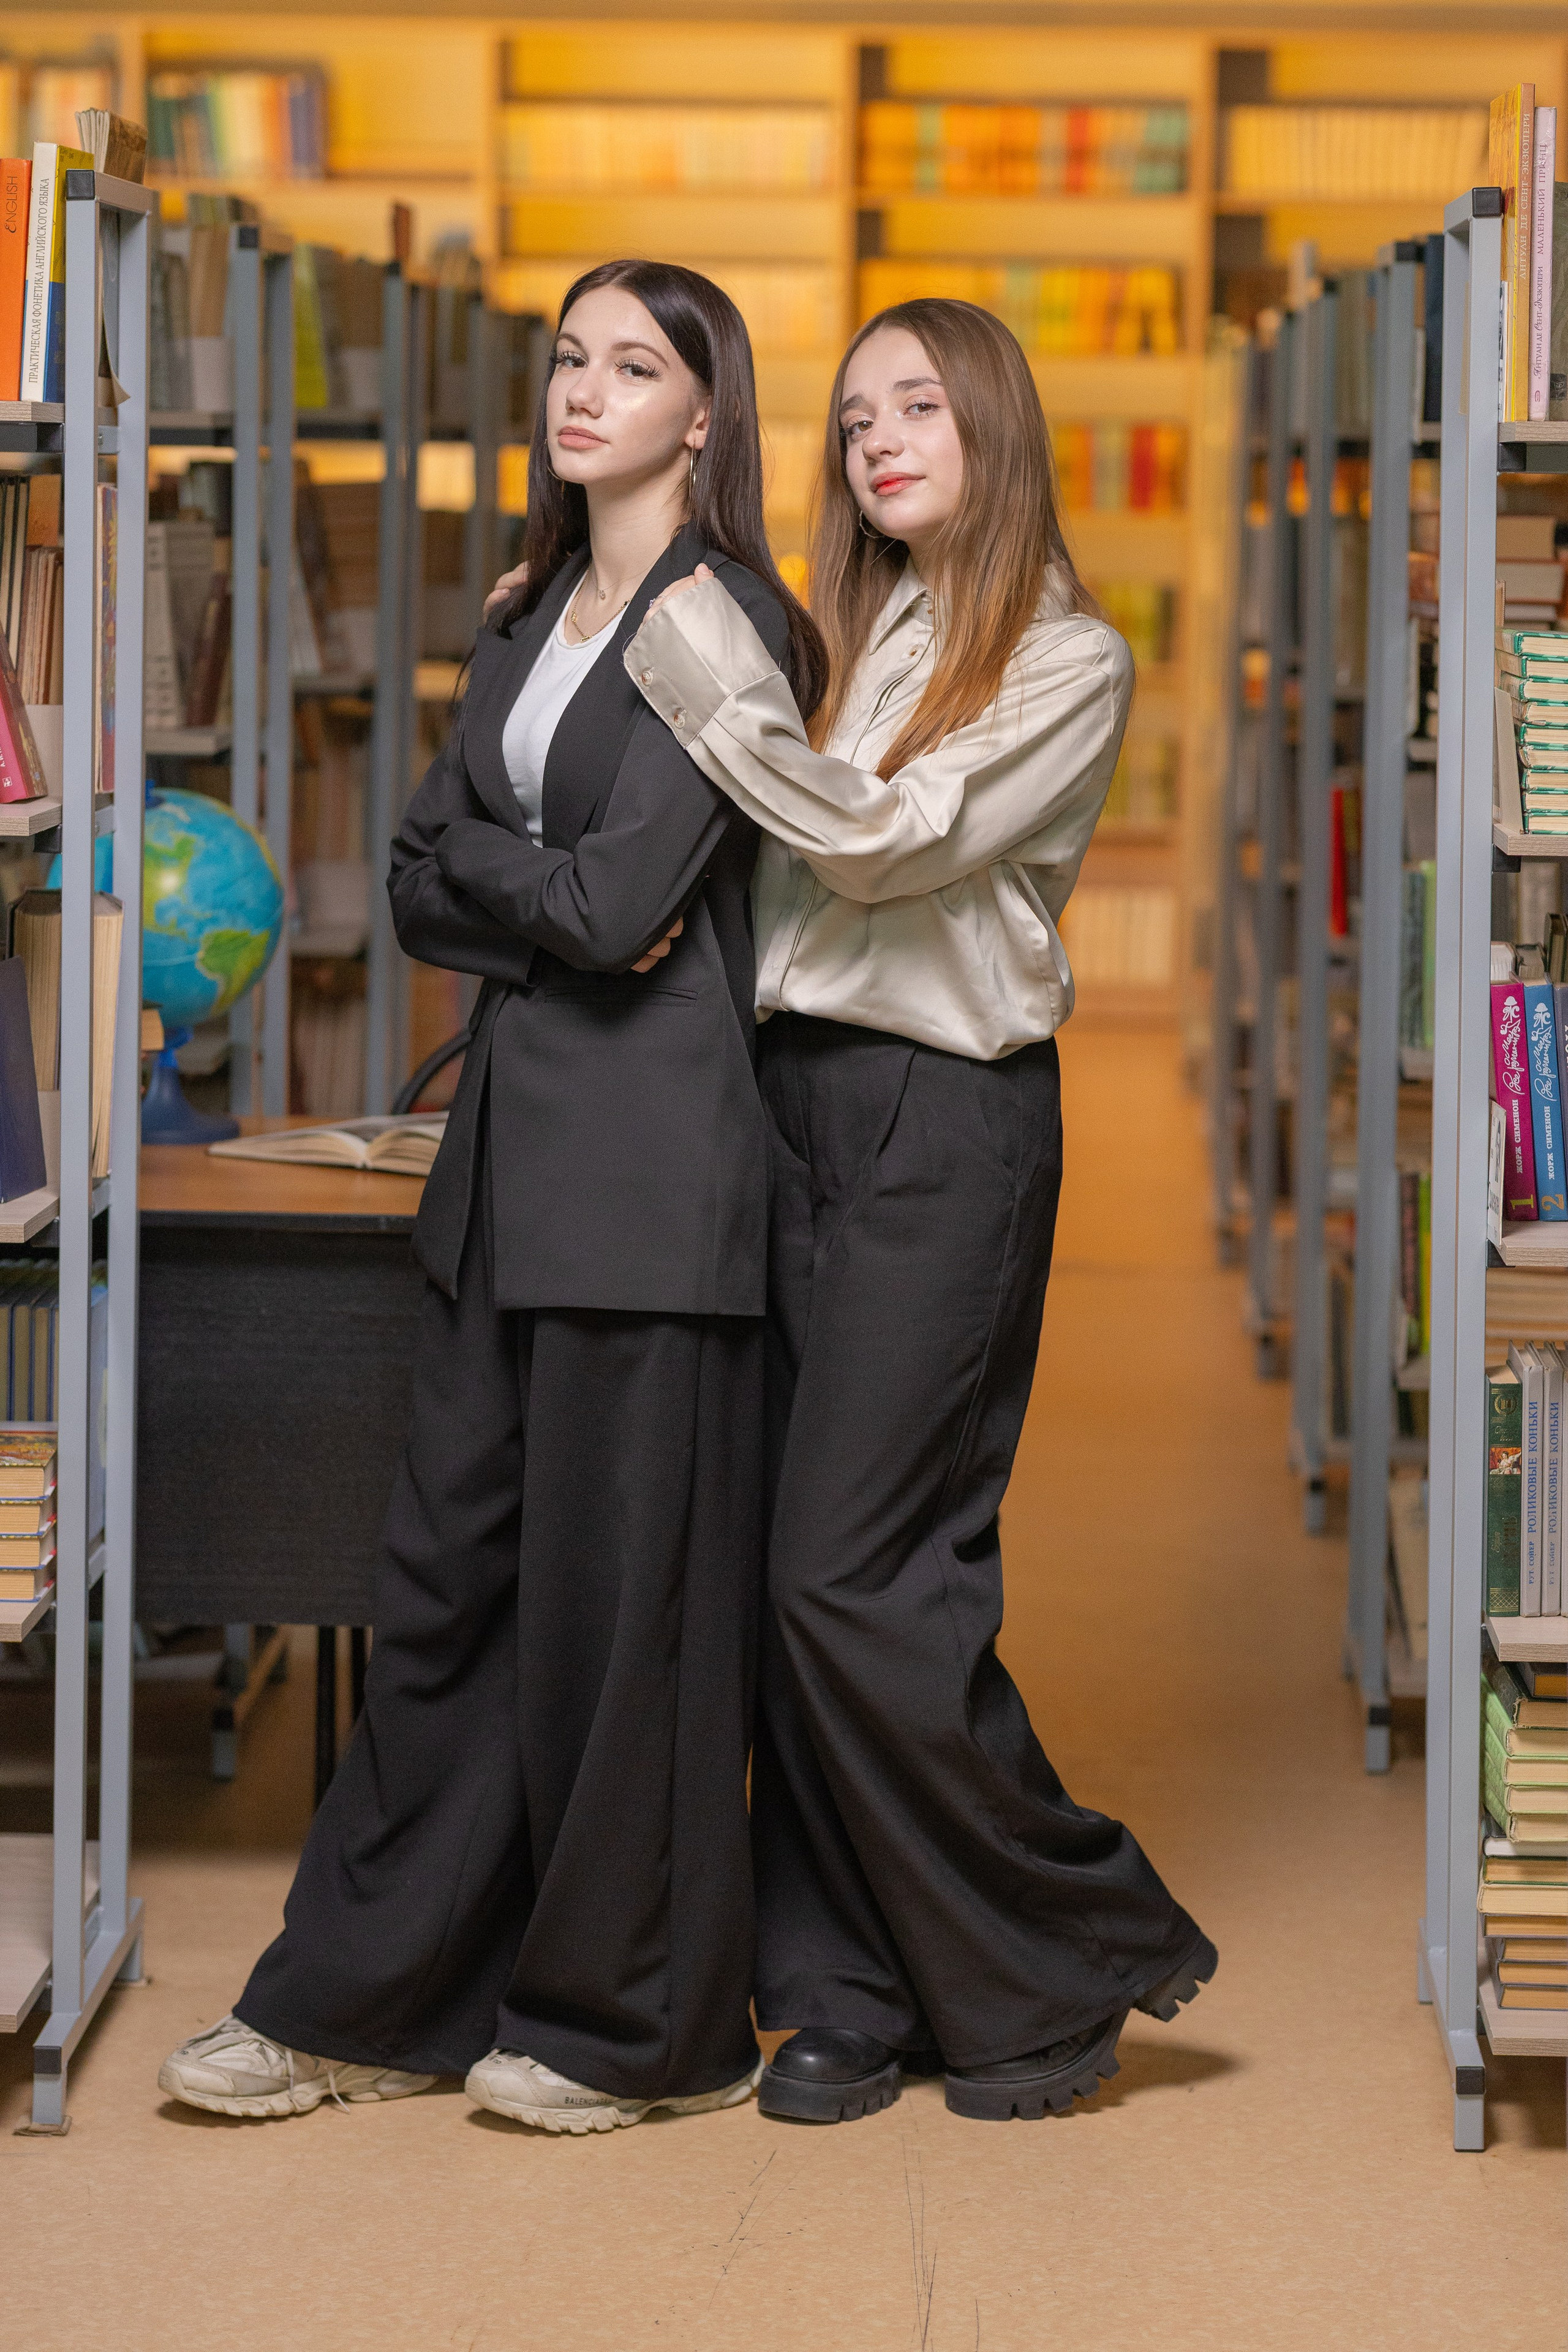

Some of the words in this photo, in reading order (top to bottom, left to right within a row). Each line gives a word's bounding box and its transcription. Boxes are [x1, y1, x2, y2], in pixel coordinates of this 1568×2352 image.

[5, 176, 18, 233] ENGLISH
[39, 178, 49, 206] ЯЗЫКА
[35, 208, 47, 270] АНГЛИЙСКОГО
[1520, 214, 1528, 230] ДЕ
[32, 271, 44, 317] ФОНЕТИКА
[29, 319, 41, 383] ПРАКТИЧЕСКАЯ
[1536, 332, 1542, 342] ДЕ
[1512, 1099, 1521, 1143] СИМЕНОН
[1510, 1194, 1534, 1210] 1
[1541, 1194, 1564, 1211] 2
[1529, 1401, 1538, 1452] КОНЬКИ
[1550, 1402, 1559, 1453] КОНЬКИ
[1528, 1458, 1537, 1533] РОЛИКОВЫЕ
